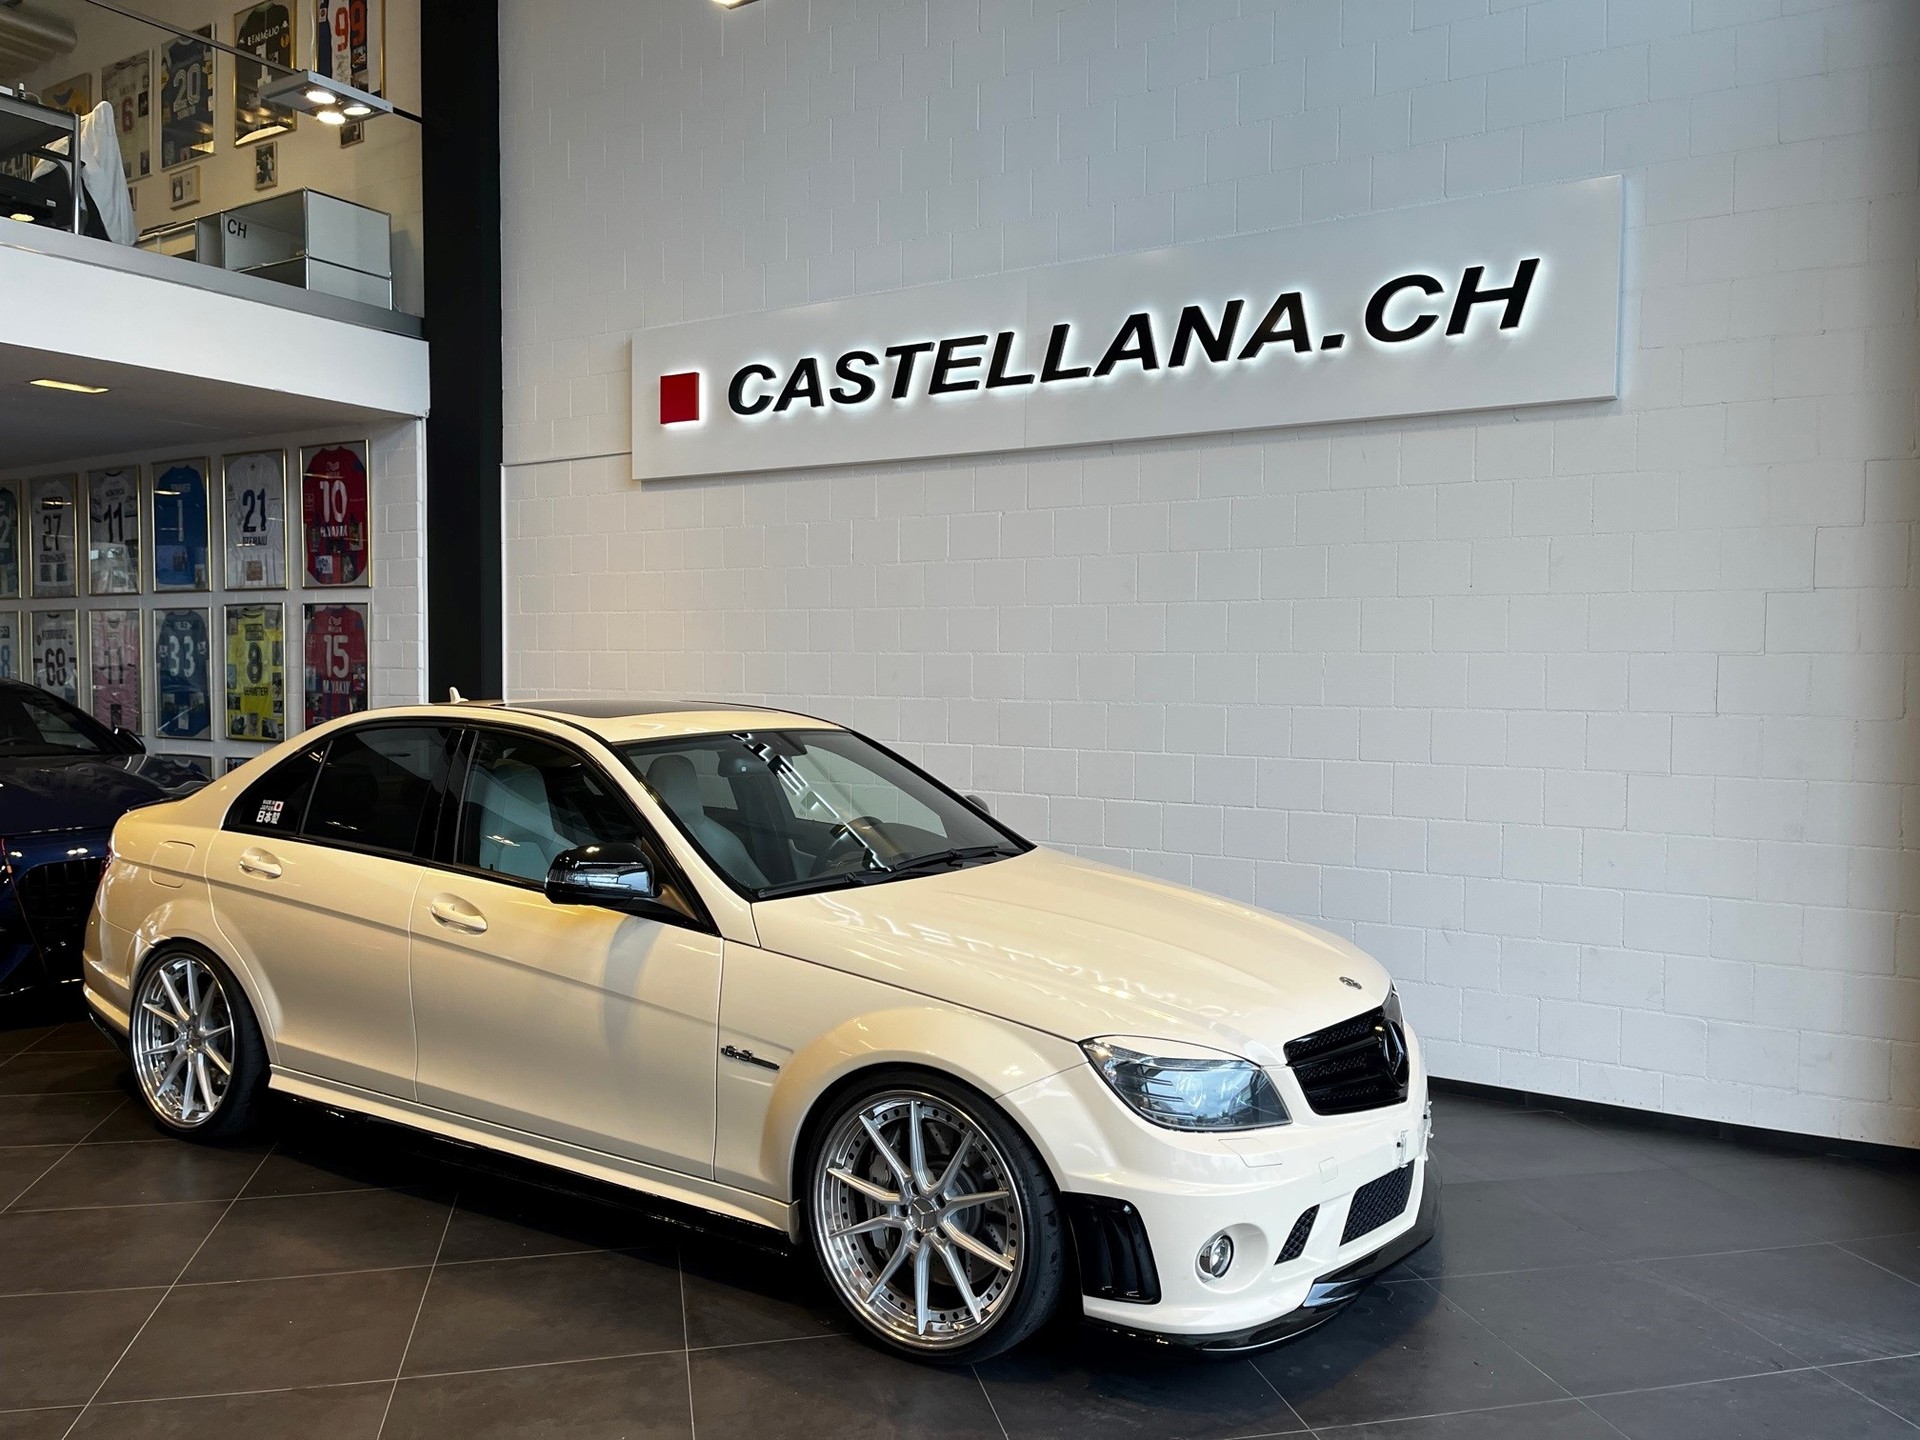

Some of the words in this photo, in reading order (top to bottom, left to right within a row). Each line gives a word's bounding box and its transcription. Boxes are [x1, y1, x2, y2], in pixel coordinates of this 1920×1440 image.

[335, 0, 366, 52] 99
[173, 63, 200, 112] 20
[122, 96, 134, 134] 6
[227, 218, 247, 239] CH
[728, 259, 1541, 416] CASTELLANA.CH
[103, 502, 124, 543] 11
[242, 488, 266, 533] 21
[319, 480, 348, 523] 10
[42, 513, 62, 551] 27
[45, 647, 67, 687] 68
[169, 635, 196, 678] 33
[246, 641, 263, 685] 8
[323, 634, 350, 678] 15
